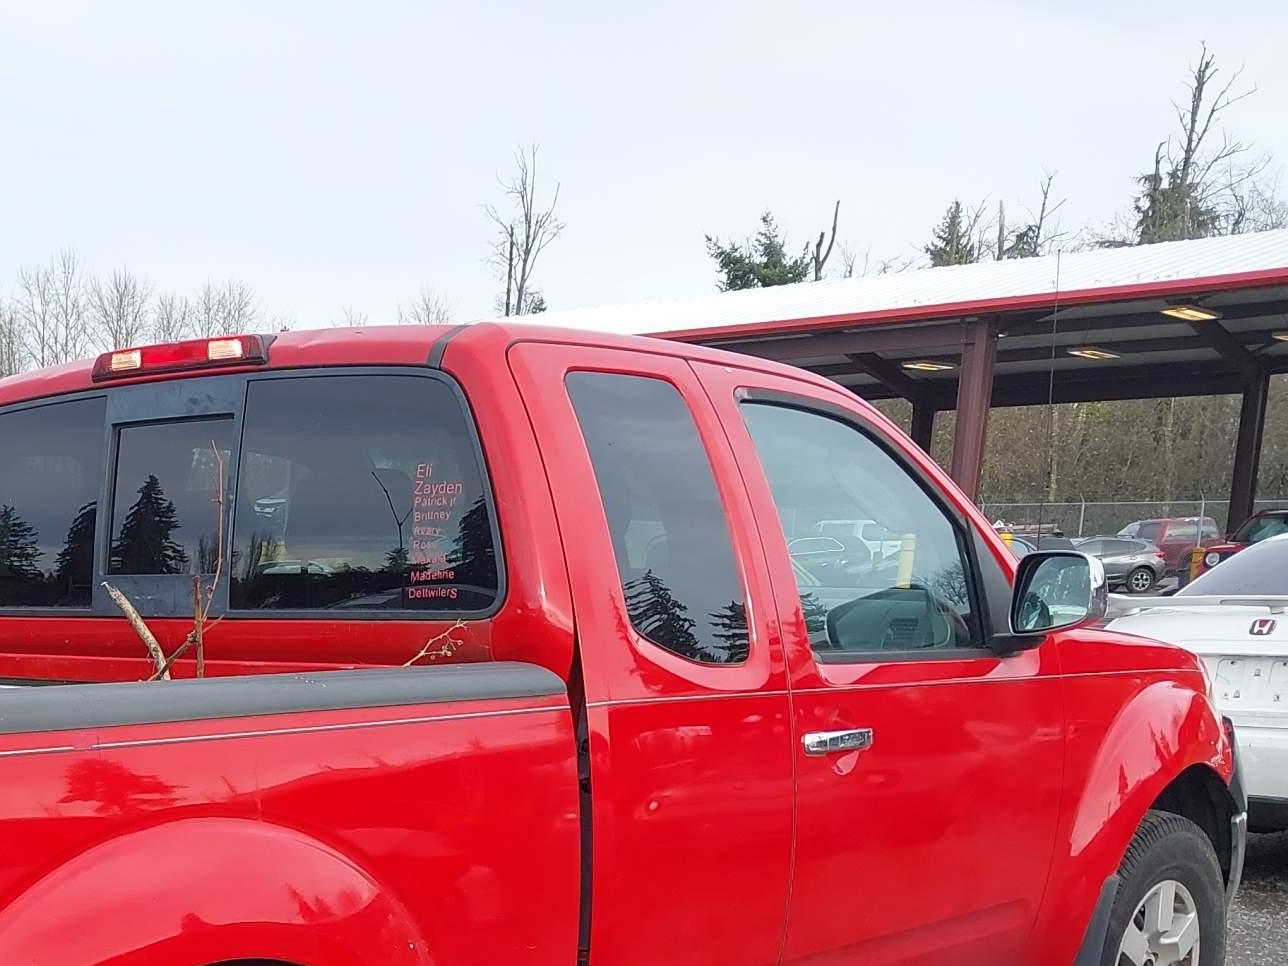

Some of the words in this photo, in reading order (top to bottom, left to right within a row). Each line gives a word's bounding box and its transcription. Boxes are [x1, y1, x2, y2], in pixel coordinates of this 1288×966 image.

[416, 463, 433, 478] Eli
[414, 481, 463, 497] Zayden
[414, 496, 447, 508] Patrick
